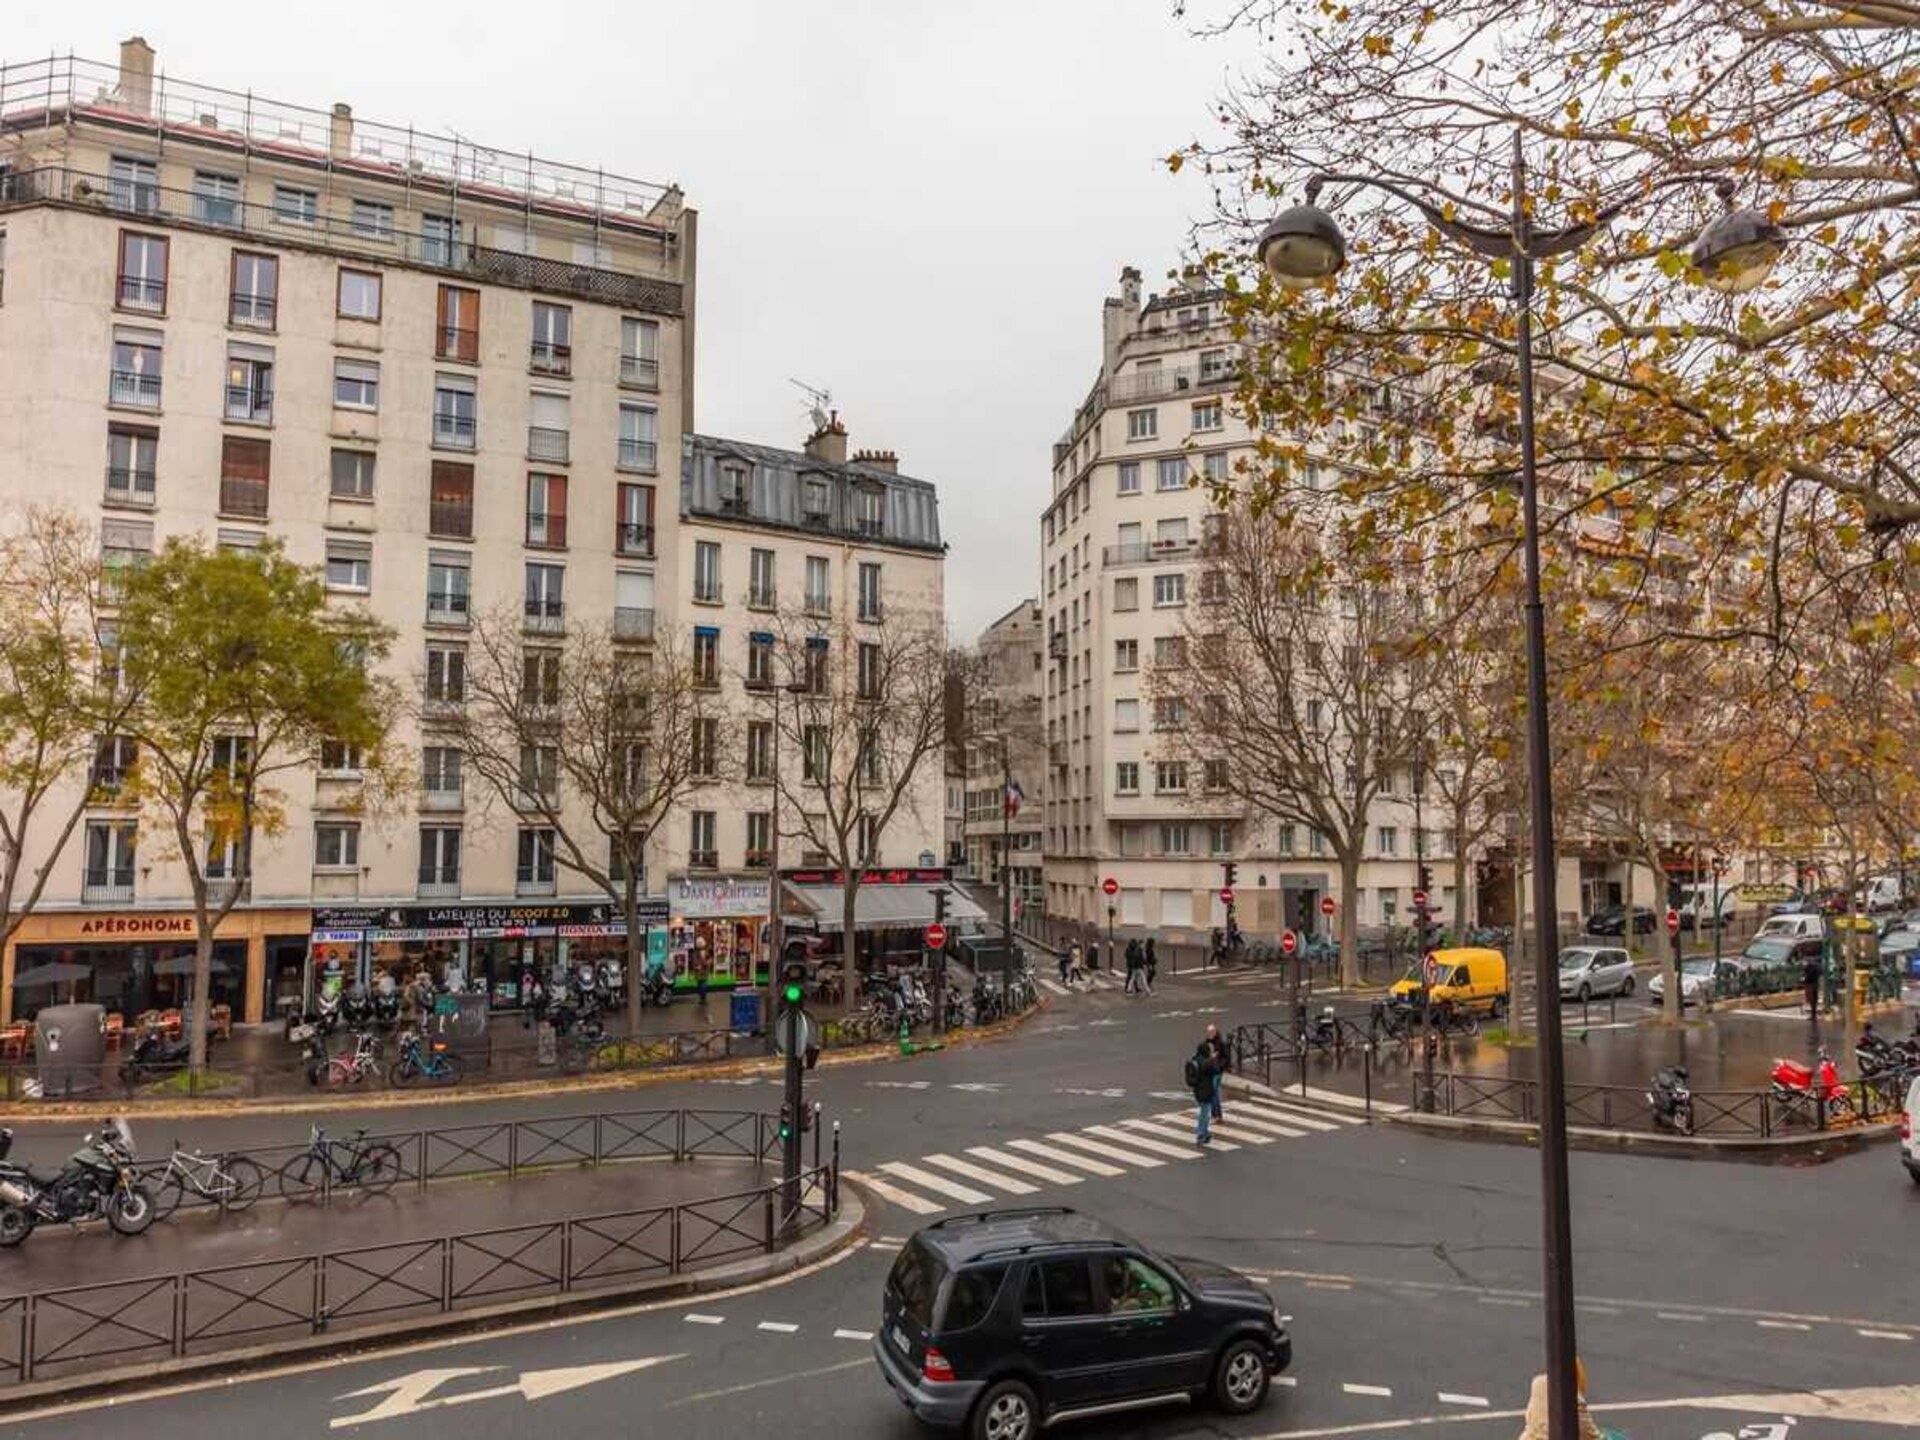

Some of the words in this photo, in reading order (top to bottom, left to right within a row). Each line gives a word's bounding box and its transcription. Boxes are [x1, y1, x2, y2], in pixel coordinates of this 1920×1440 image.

[428, 908, 486, 921] L'ATELIER
[488, 908, 507, 920] DU
[511, 907, 549, 920] SCOOT
[82, 917, 193, 933] APÉRONOME
[560, 925, 604, 936] HONDA
[377, 930, 419, 940] PIAGGIO
